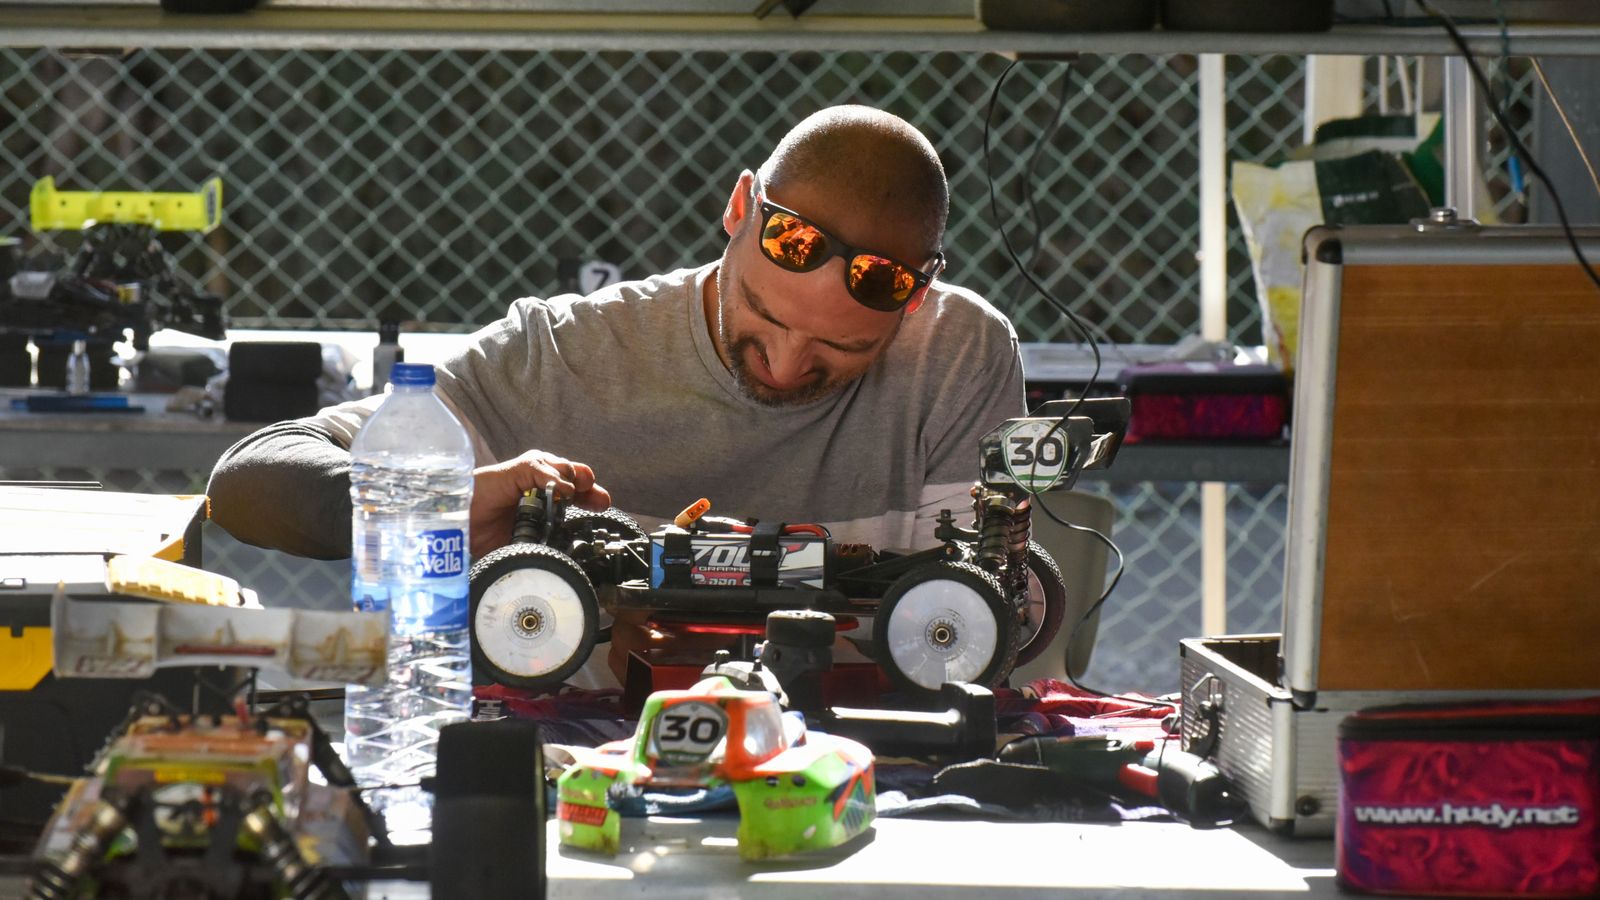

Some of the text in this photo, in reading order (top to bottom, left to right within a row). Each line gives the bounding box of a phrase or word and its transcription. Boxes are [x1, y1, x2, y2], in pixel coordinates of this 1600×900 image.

[592, 268, 610, 290] 7
[1010, 436, 1064, 466] 30
[420, 533, 462, 554] Font
[421, 552, 462, 574] Vella
[660, 714, 721, 743] 30
[1354, 803, 1580, 829] www.hudy.net
